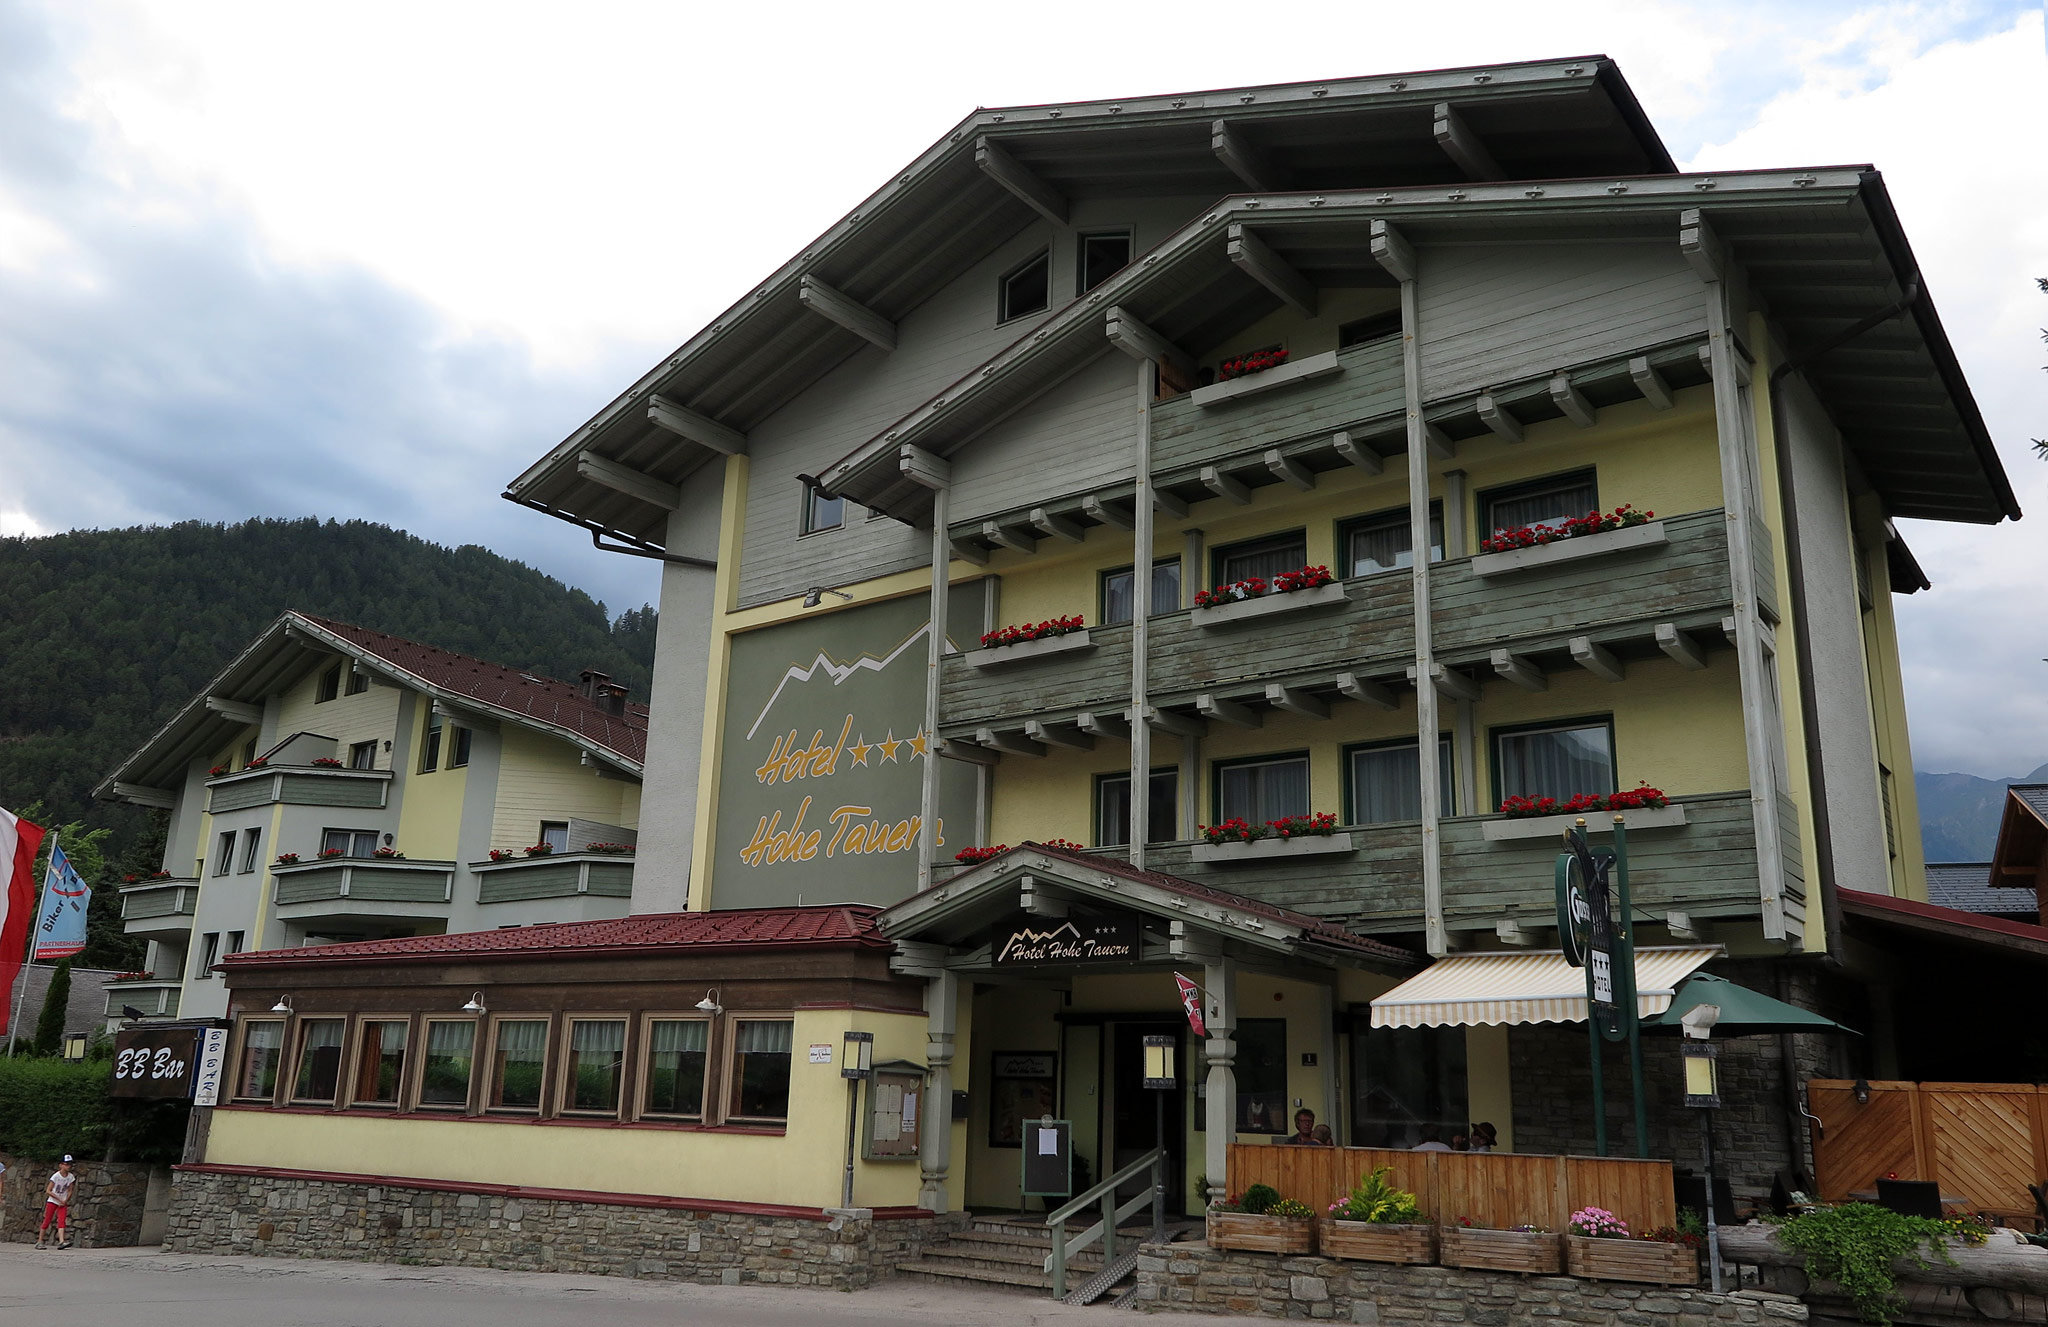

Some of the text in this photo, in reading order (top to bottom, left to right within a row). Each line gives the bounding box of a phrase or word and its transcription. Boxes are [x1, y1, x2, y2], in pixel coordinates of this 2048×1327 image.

[756, 713, 854, 785] Hotel
[739, 795, 822, 867] Hohe
[42, 900, 65, 933] Biker
[1011, 939, 1131, 961] Hotel Hohe Tauern
[1593, 976, 1612, 993] HOTEL
[115, 1047, 185, 1080] BB Bar
